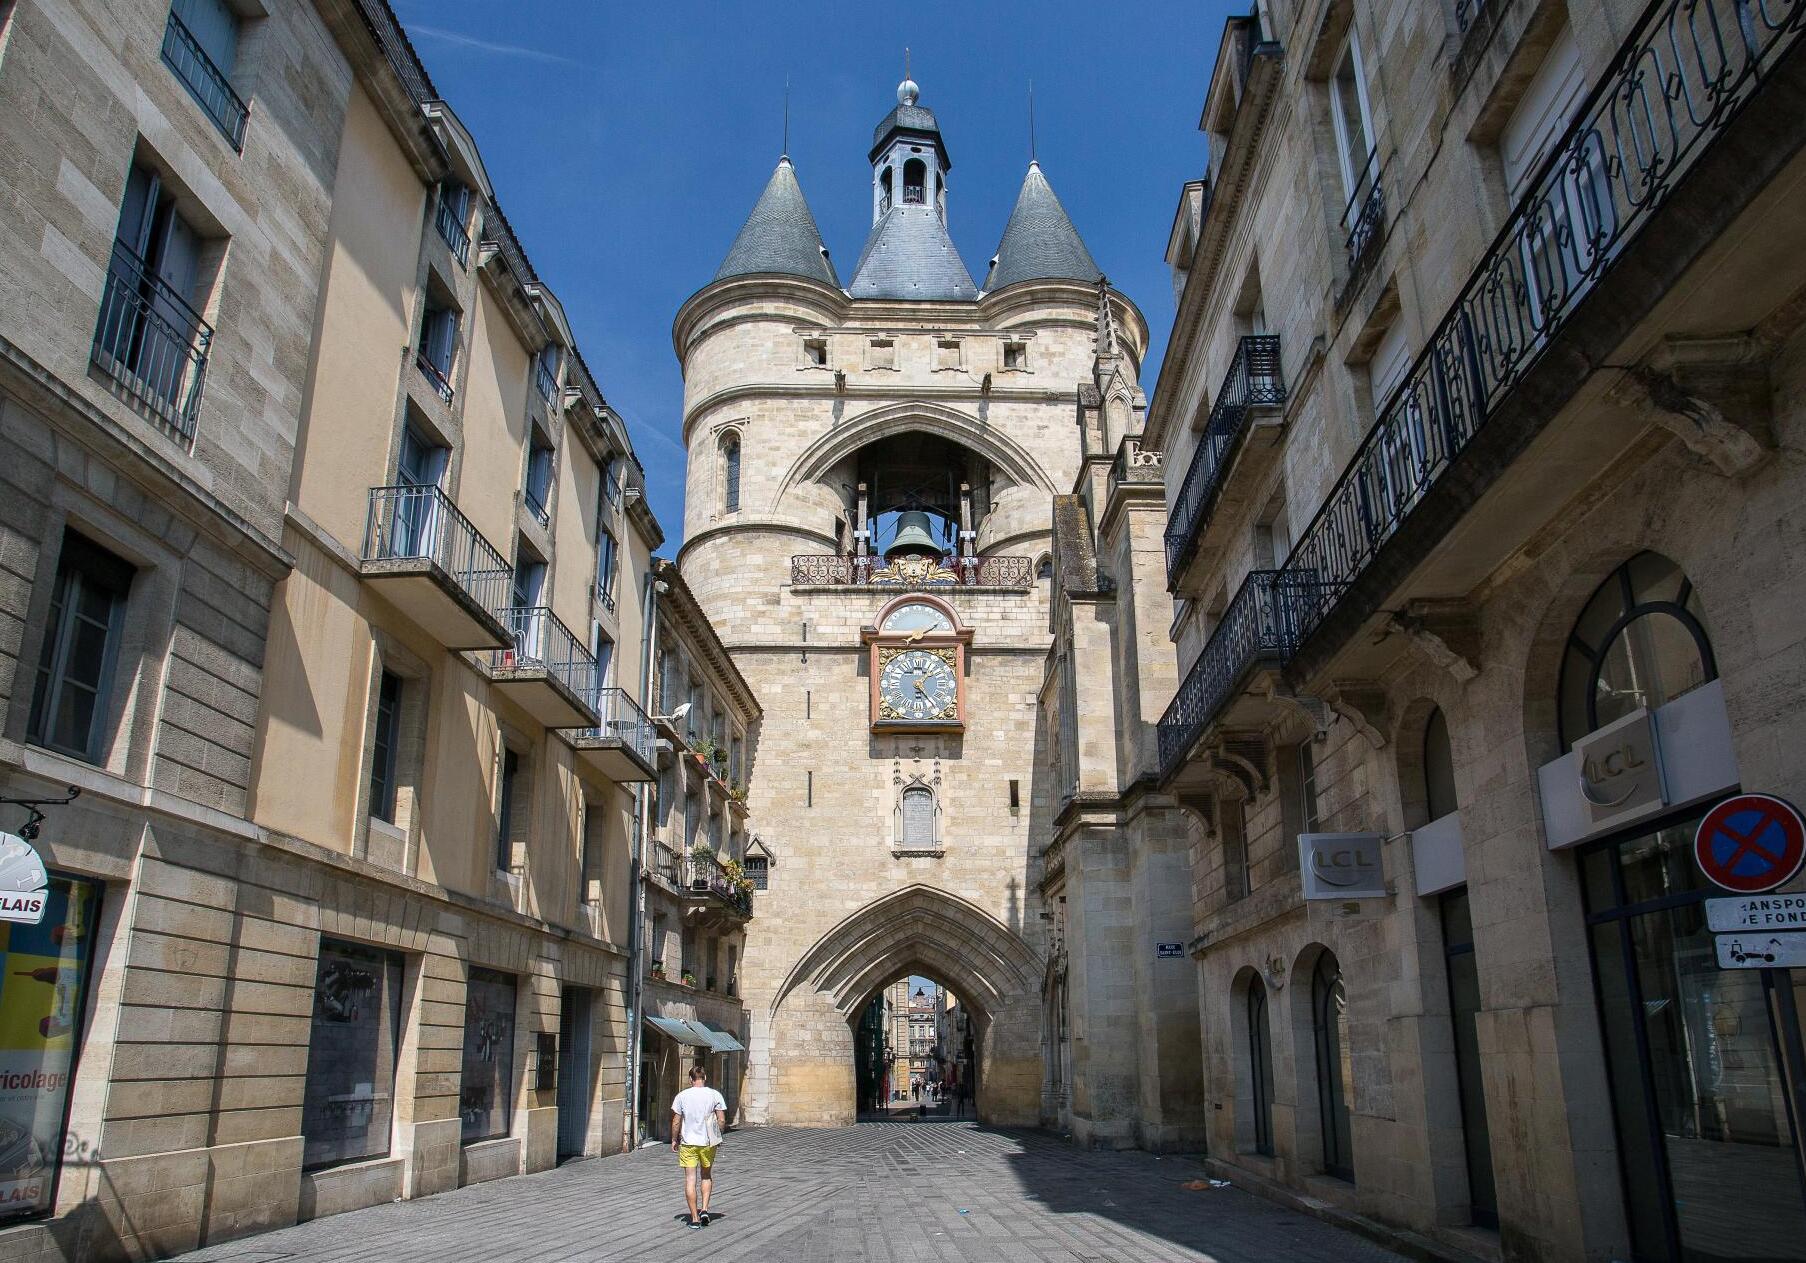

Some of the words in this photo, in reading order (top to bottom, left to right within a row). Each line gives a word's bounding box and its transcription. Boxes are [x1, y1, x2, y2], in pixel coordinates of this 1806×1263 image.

[1588, 744, 1645, 784] LCL
[1317, 850, 1375, 868] LCL
[0, 898, 41, 912] LAIS
